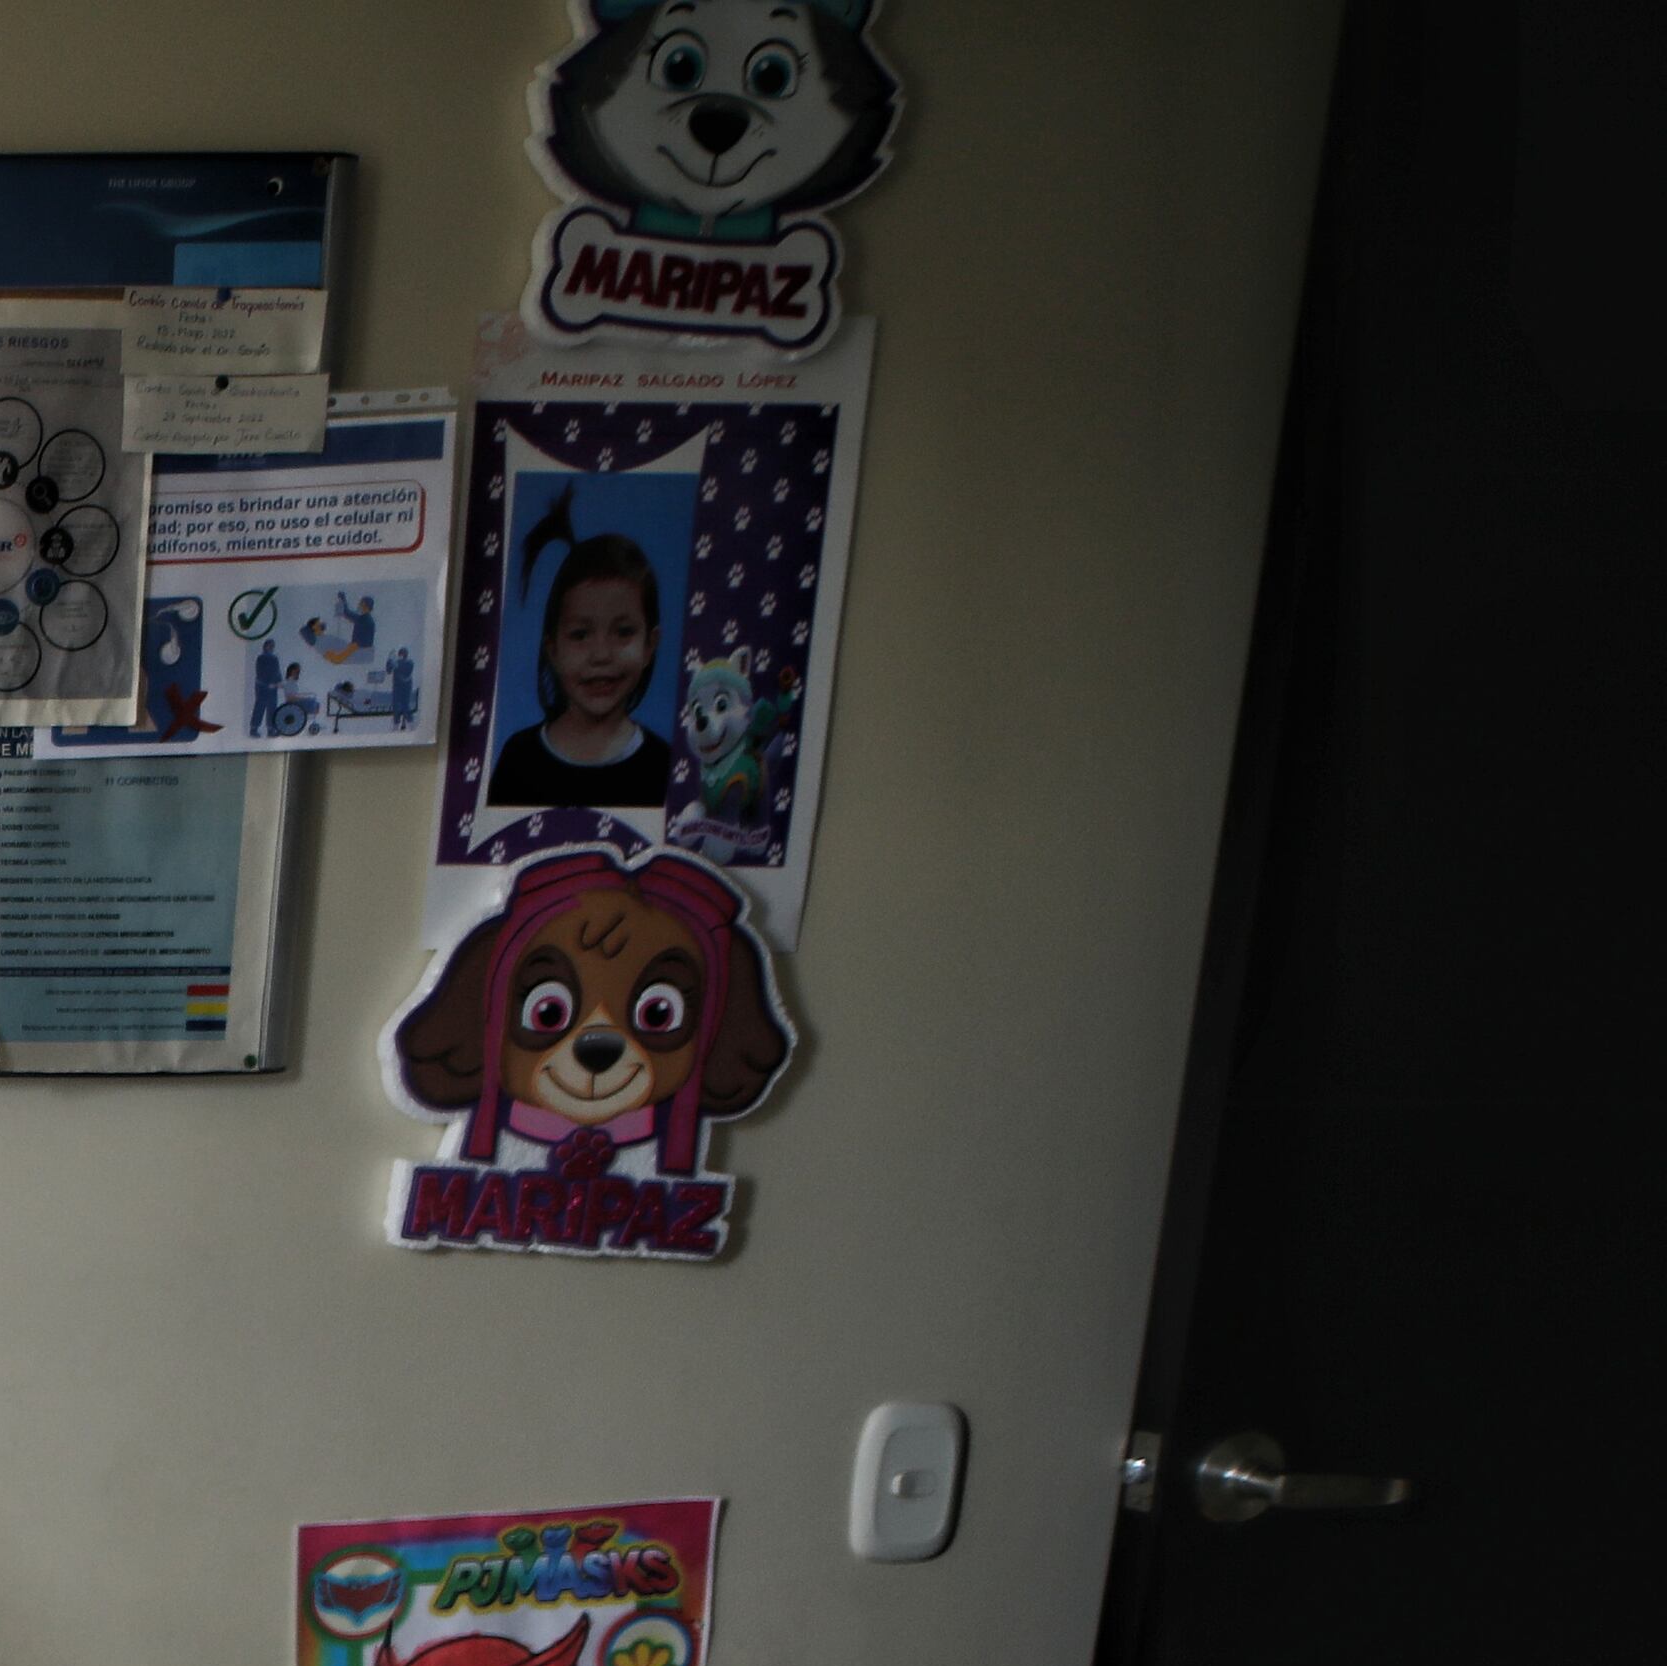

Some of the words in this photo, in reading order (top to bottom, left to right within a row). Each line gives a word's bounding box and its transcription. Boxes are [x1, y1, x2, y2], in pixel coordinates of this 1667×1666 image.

[565, 244, 814, 320] MARIPAZ
[7, 336, 69, 349] RIESGOS
[217, 502, 235, 513] es
[239, 496, 300, 513] brindar
[306, 496, 338, 508] una
[343, 488, 418, 506] atención
[186, 519, 213, 538] por
[217, 520, 251, 534] eso,
[255, 518, 276, 530] no
[281, 516, 310, 530] uso
[315, 513, 331, 528] el
[335, 509, 391, 526] celular
[397, 508, 413, 522] ni
[227, 534, 300, 552] mientras
[305, 532, 322, 548] te
[415, 1170, 723, 1252] MARIPAZ
